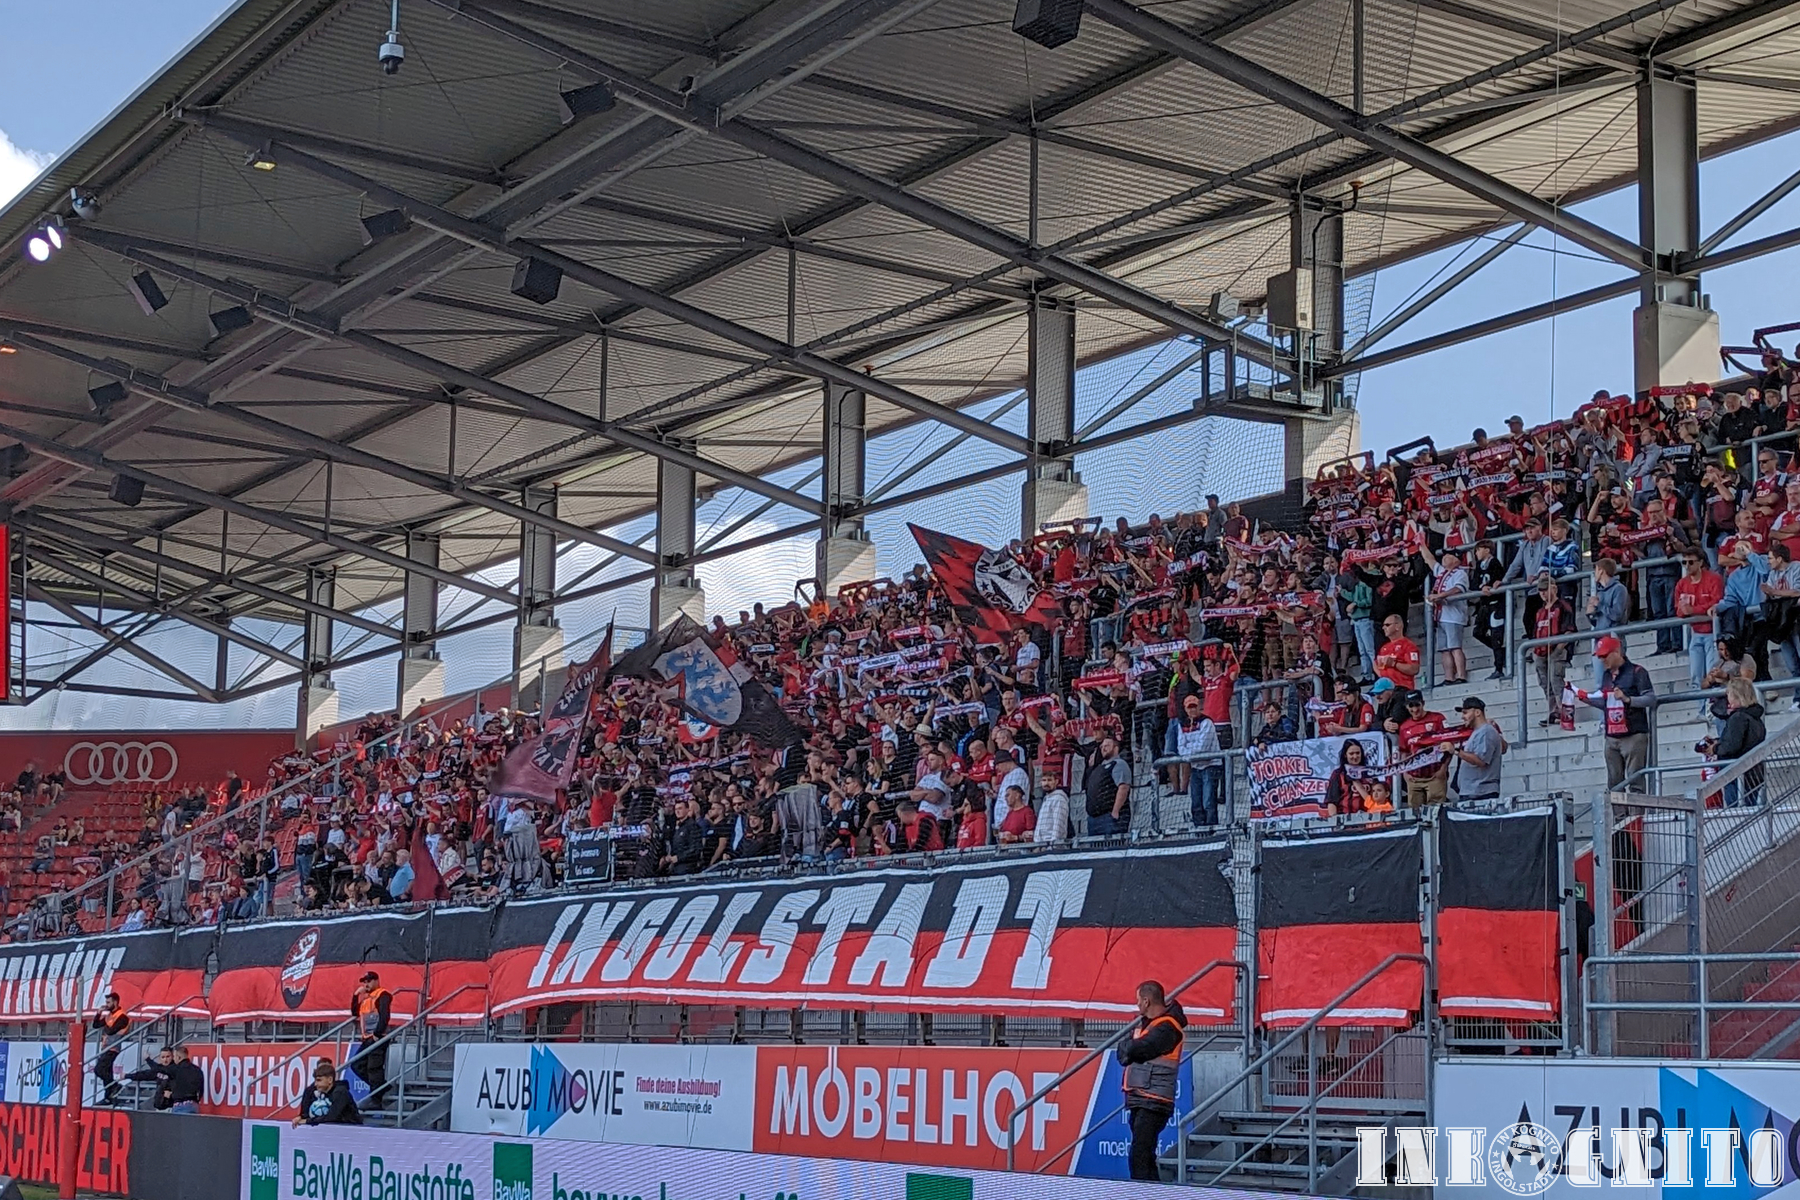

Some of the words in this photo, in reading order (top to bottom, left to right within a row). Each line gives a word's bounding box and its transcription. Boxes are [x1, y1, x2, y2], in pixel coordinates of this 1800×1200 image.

[1251, 756, 1313, 783] TORKEL
[527, 868, 1093, 989] INGOLSTADT
[476, 1067, 539, 1111] AZUBI
[547, 1068, 625, 1116] MOVIE
[636, 1076, 654, 1093] Finde
[656, 1077, 676, 1094] deine
[677, 1078, 721, 1098] Ausbildung!
[644, 1098, 712, 1114] www.azubimovie.de
[0, 1104, 131, 1194] SCHAZER
[252, 1154, 278, 1181] BayWa
[293, 1149, 362, 1200] BayWa
[369, 1155, 474, 1200] Baustoffe
